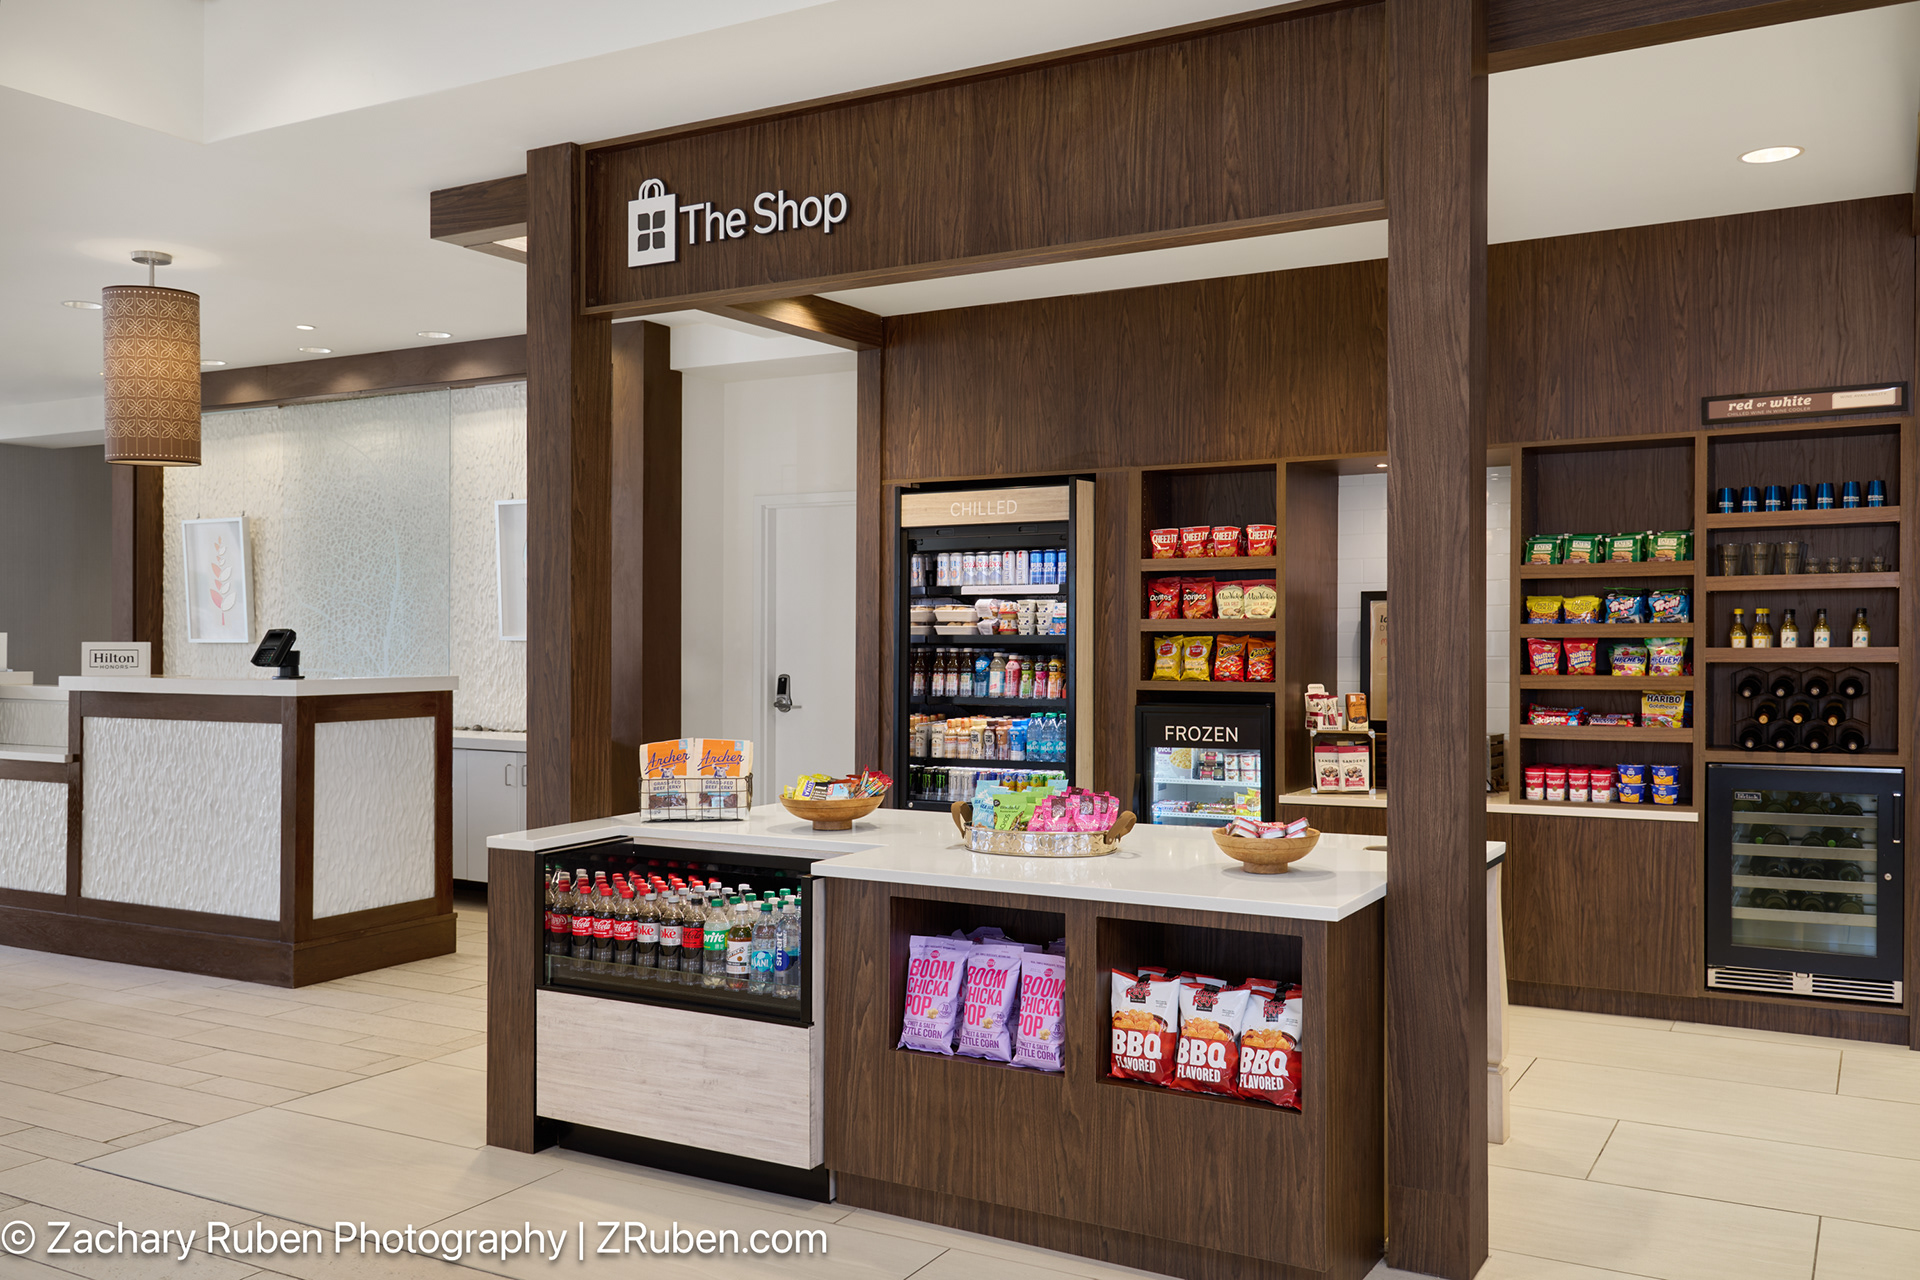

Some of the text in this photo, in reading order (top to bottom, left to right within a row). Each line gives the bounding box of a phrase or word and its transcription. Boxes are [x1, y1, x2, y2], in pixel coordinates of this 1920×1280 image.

[679, 189, 848, 245] The Shop
[1728, 399, 1753, 411] red
[1770, 395, 1812, 408] white
[950, 500, 1018, 517] CHILLED
[1150, 594, 1172, 602] Doritos
[1183, 593, 1207, 601] Doritos
[1608, 598, 1634, 612] Trolli
[1653, 596, 1680, 612] Trolli
[94, 653, 134, 663] Hilton
[1533, 652, 1555, 662] Nutter
[1535, 657, 1556, 667] Butter
[1569, 650, 1592, 660] Nutter
[1570, 656, 1592, 667] Butter
[1647, 694, 1681, 703] HARIBO
[1165, 725, 1239, 742] FROZEN
[644, 749, 691, 771] Archer
[697, 749, 744, 768] Archer
[637, 925, 654, 935] oke
[660, 928, 676, 938] oke
[704, 932, 725, 943] prite
[910, 958, 955, 981] BOOM
[968, 966, 1009, 989] BOOM
[907, 977, 949, 997] CHICKA
[1022, 974, 1066, 999] BOOM
[905, 994, 932, 1016] POP
[1020, 995, 1060, 1017] CHICKA
[903, 1026, 943, 1039] ETTLE CORN
[923, 1022, 936, 1030] SALTY
[961, 1035, 1000, 1049] ETTLE CORN
[1112, 1028, 1162, 1060] BBQ
[1017, 1046, 1056, 1061] ETTLE CORN
[1177, 1037, 1227, 1069] BBQ
[1115, 1055, 1156, 1073] FLAVORED
[1240, 1046, 1290, 1077] BBQ
[1177, 1064, 1221, 1083] FLAVORED
[1239, 1073, 1284, 1091] FLAVORED
